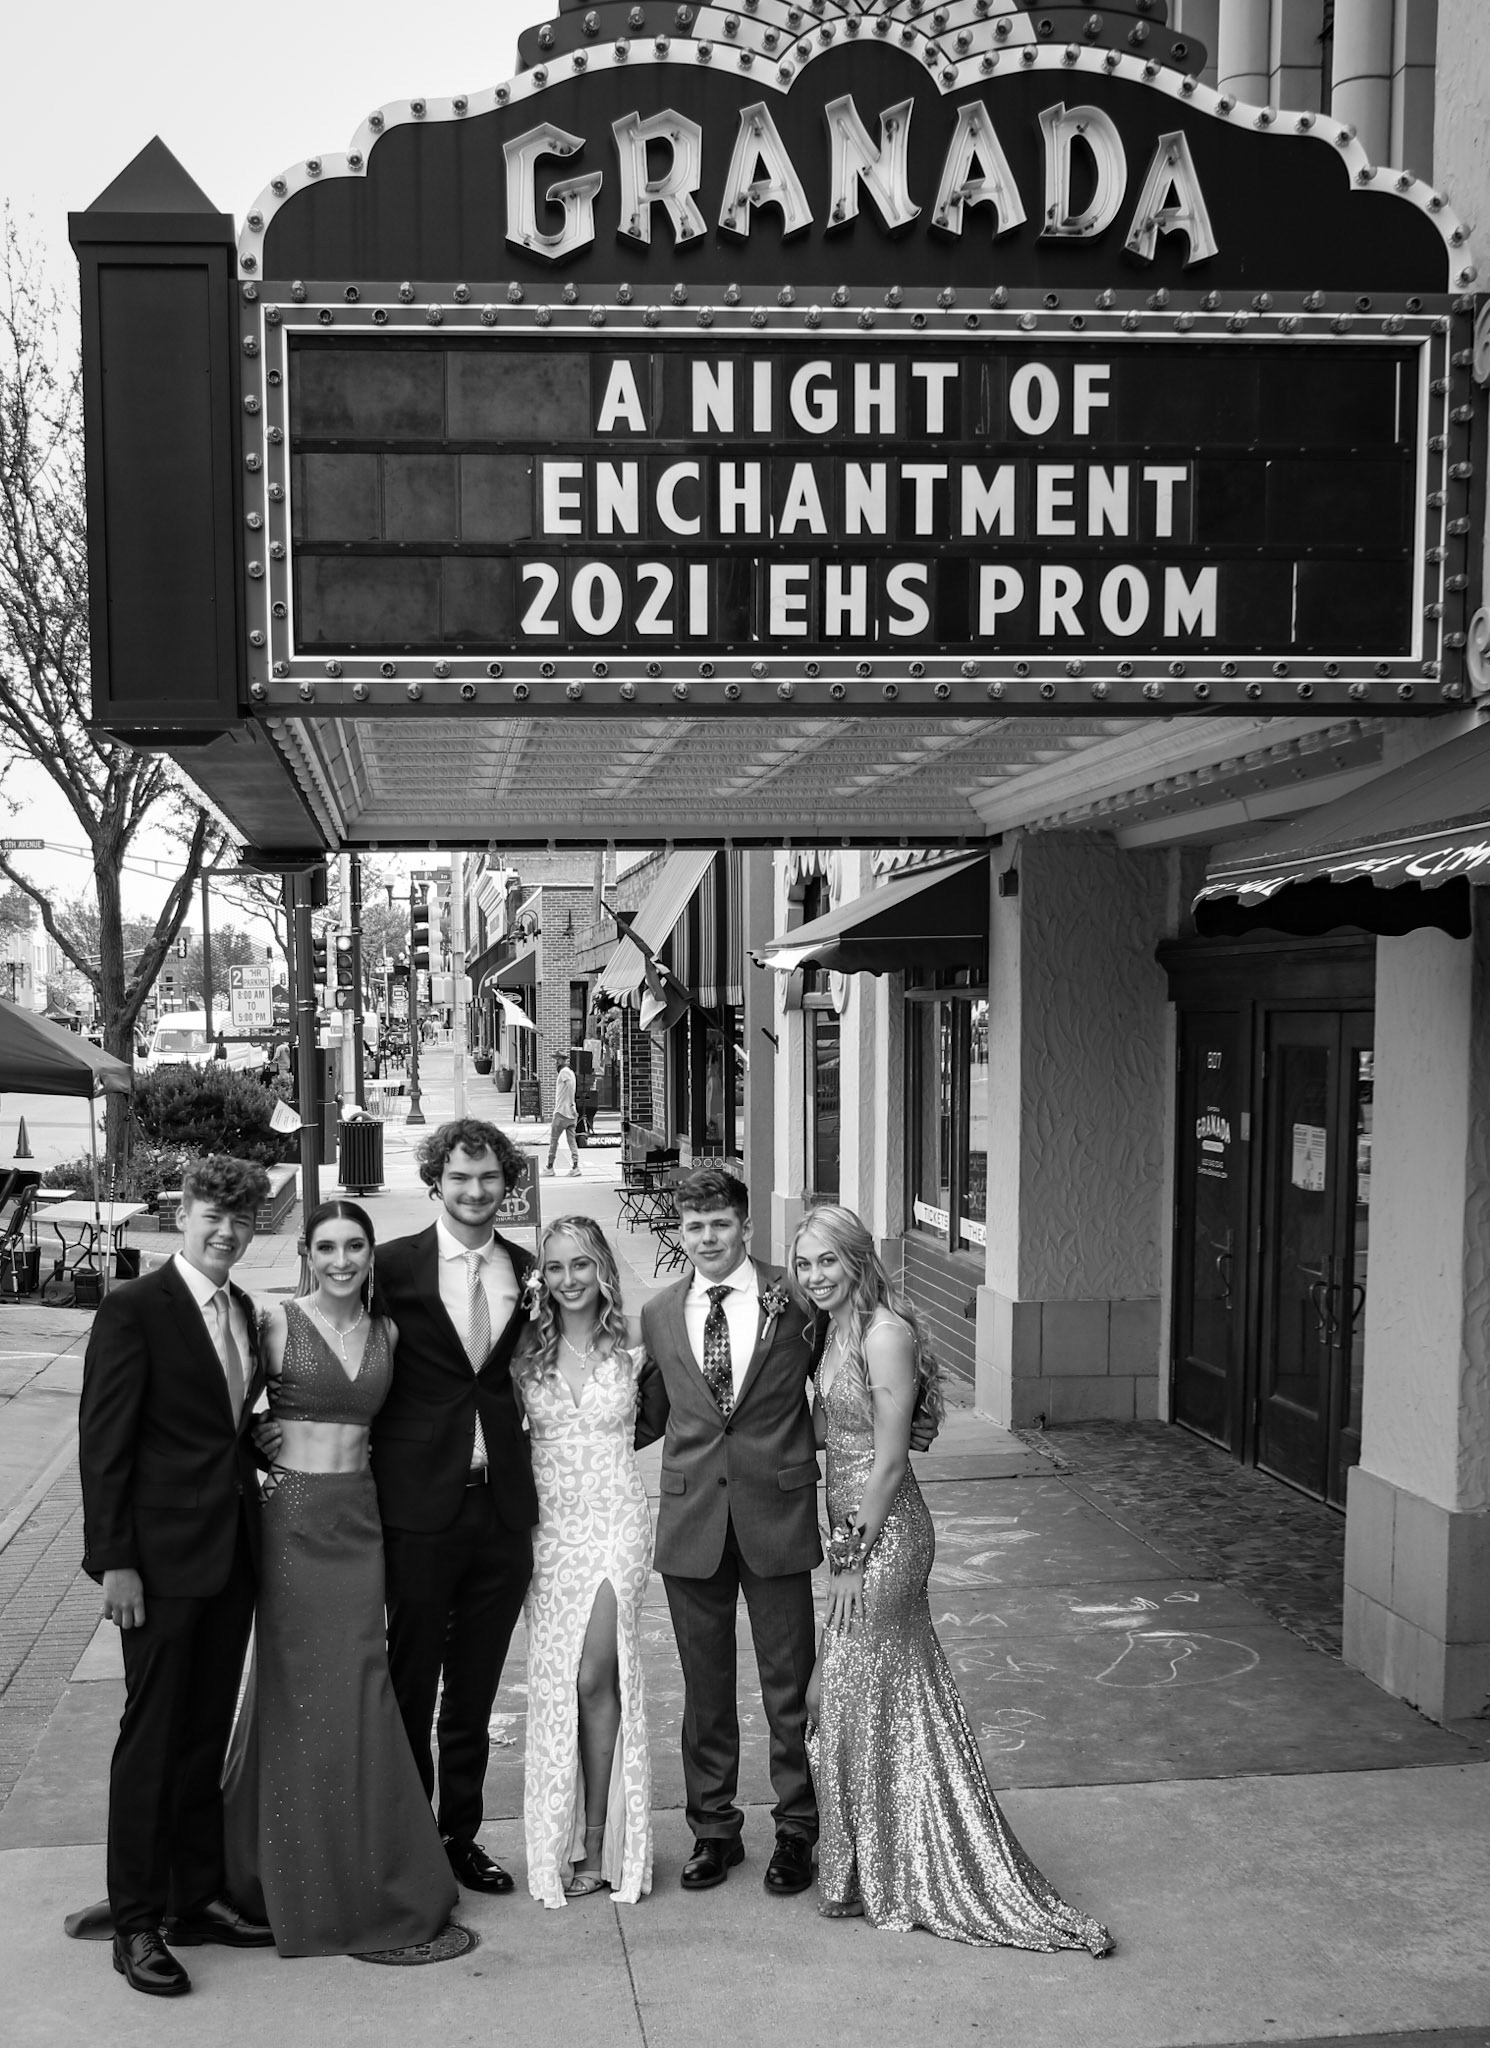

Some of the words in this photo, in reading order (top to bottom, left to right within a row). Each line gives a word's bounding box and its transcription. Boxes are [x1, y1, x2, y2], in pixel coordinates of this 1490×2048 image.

[502, 93, 1220, 264] GRANADA
[596, 359, 647, 432] A
[692, 360, 959, 434] NIGHT
[1009, 362, 1110, 435] OF
[542, 461, 1187, 537] ENCHANTMENT
[520, 562, 708, 636] 2021
[769, 562, 930, 636] EHS
[979, 564, 1218, 637] PROM
[18, 840, 43, 849] AVENUE
[232, 970, 242, 986] 2
[251, 969, 262, 977] HR
[243, 978, 269, 987] PARKING
[253, 990, 265, 999] AM
[247, 1001, 256, 1011] TO
[255, 1012, 266, 1021] PM
[1196, 1114, 1231, 1144] GRANADA
[923, 1206, 948, 1229] TICKETS
